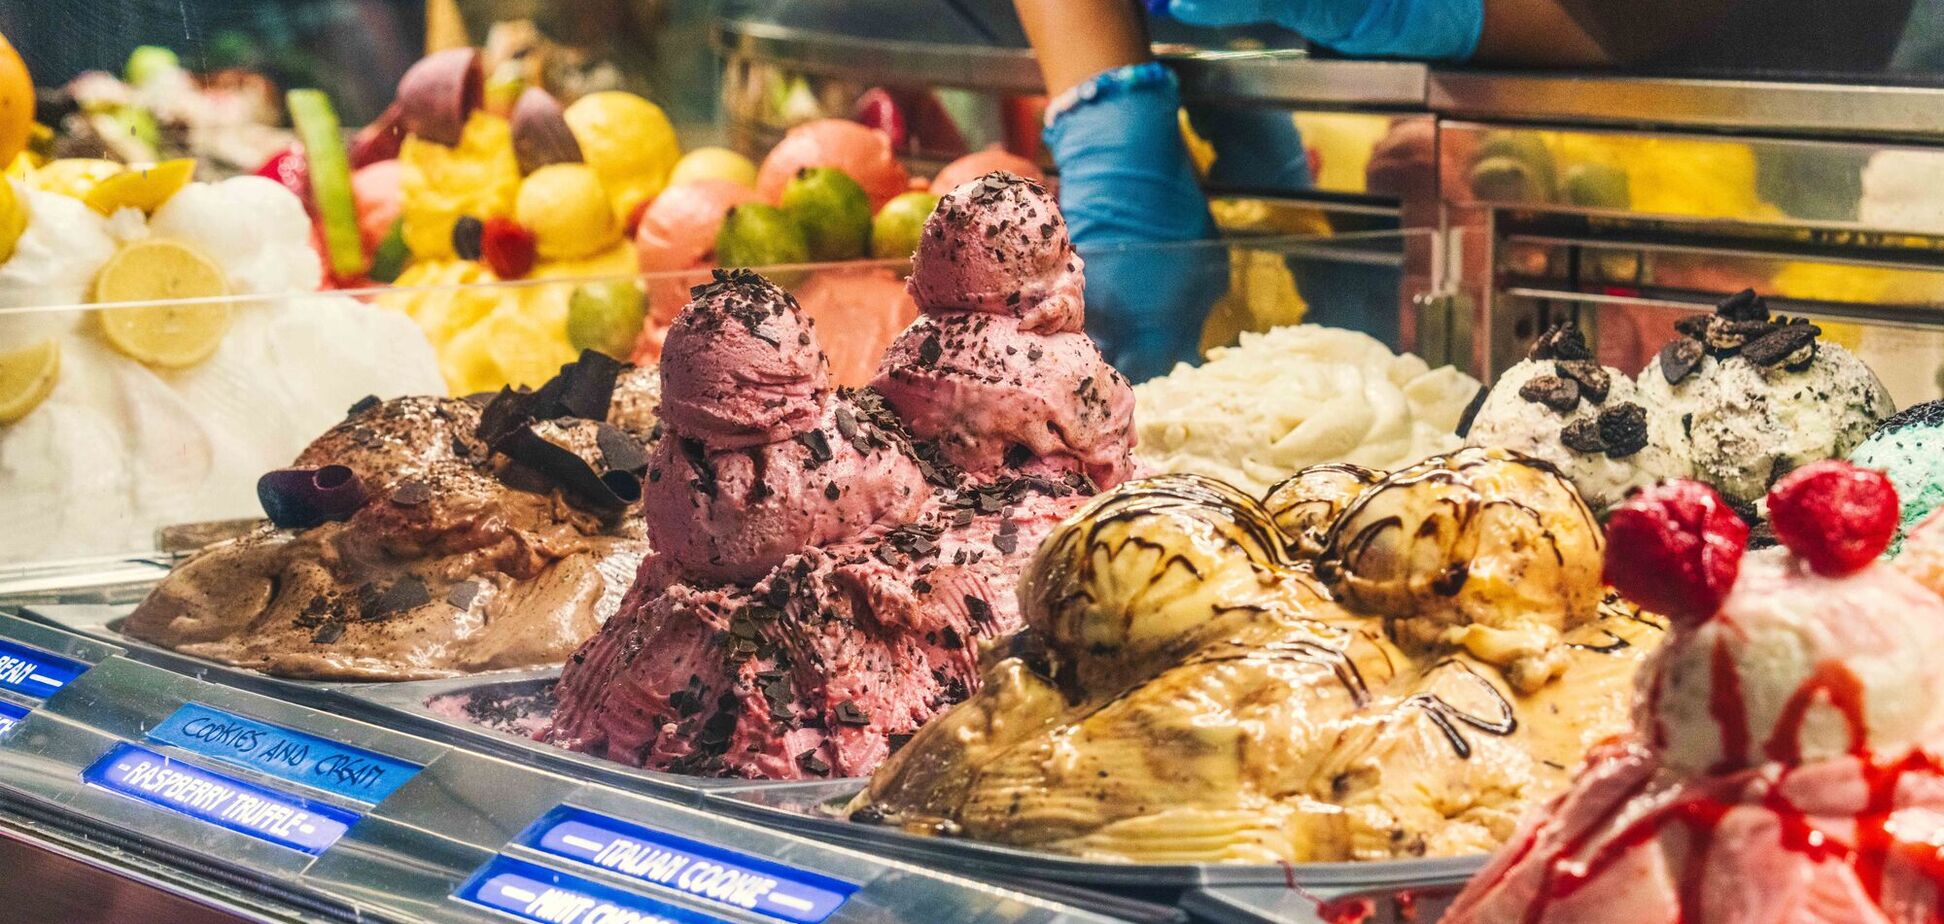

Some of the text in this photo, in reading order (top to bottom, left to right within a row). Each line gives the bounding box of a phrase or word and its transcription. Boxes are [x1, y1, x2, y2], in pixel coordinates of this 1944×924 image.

[182, 717, 385, 789] COOKIES AND CREAM
[525, 888, 596, 924] MINT
[593, 838, 778, 908] ITALIAN COOKIE
